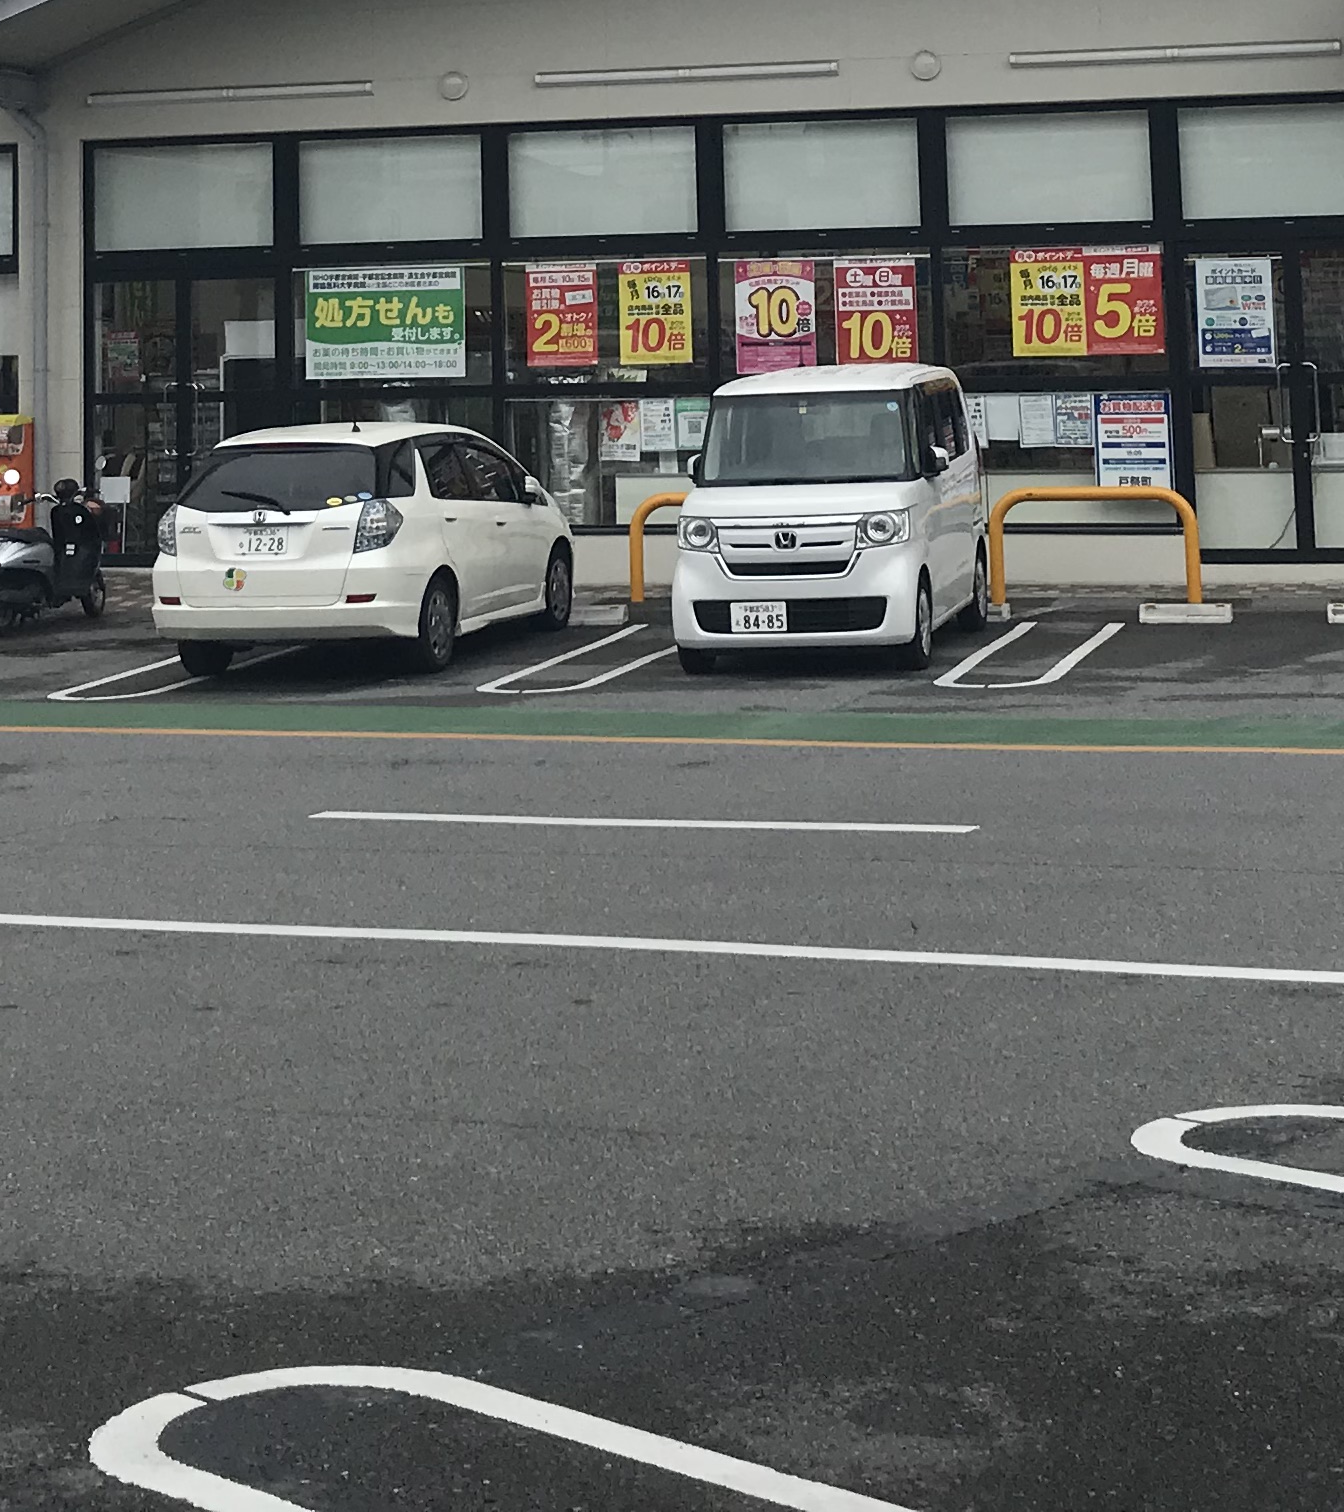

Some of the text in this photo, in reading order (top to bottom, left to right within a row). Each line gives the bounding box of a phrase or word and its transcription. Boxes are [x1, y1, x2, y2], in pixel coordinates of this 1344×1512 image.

[314, 295, 455, 328] 処方せんも
[248, 536, 284, 552] 12-28
[743, 613, 784, 629] 84-85
